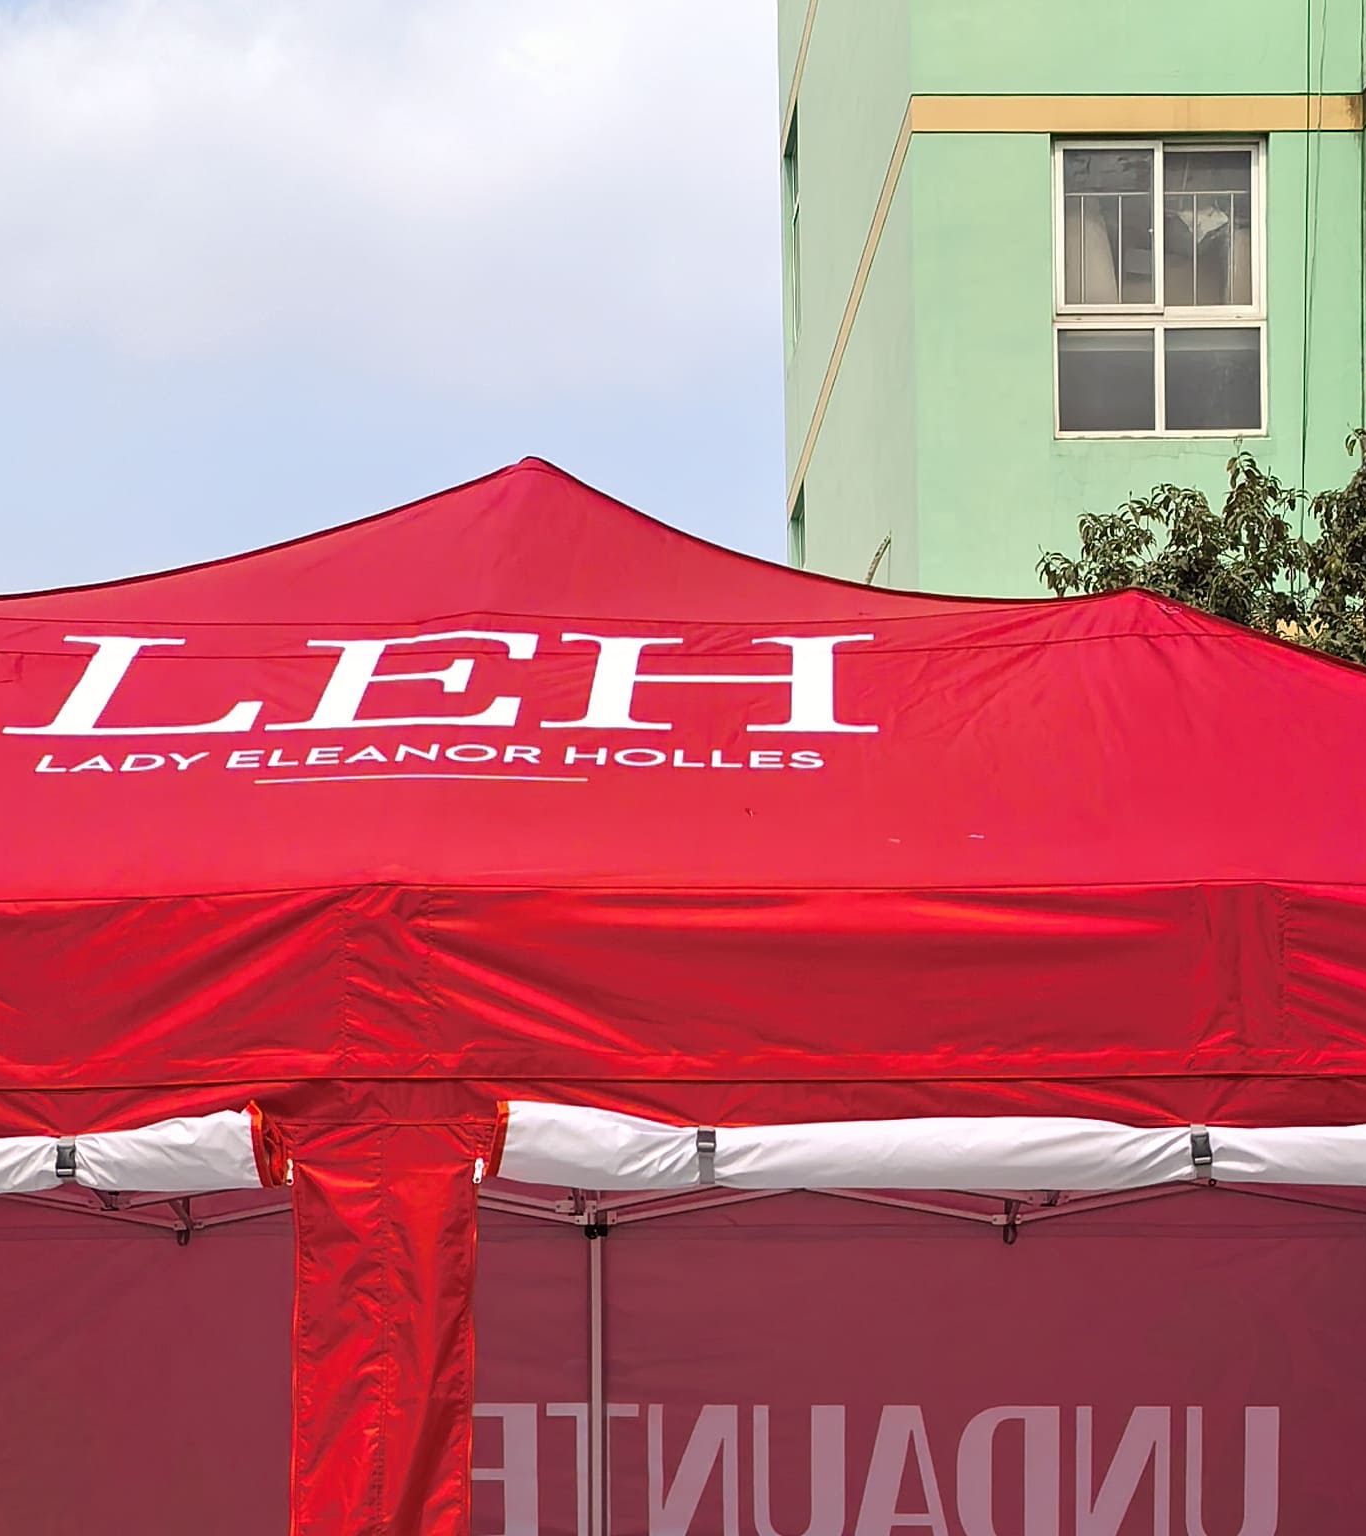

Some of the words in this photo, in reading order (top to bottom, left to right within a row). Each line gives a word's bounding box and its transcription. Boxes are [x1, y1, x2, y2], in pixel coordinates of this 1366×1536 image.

[2, 630, 880, 736] LEH
[35, 751, 210, 774] LADY
[225, 743, 542, 770] ELEANOR
[563, 746, 825, 771] HOLLES
